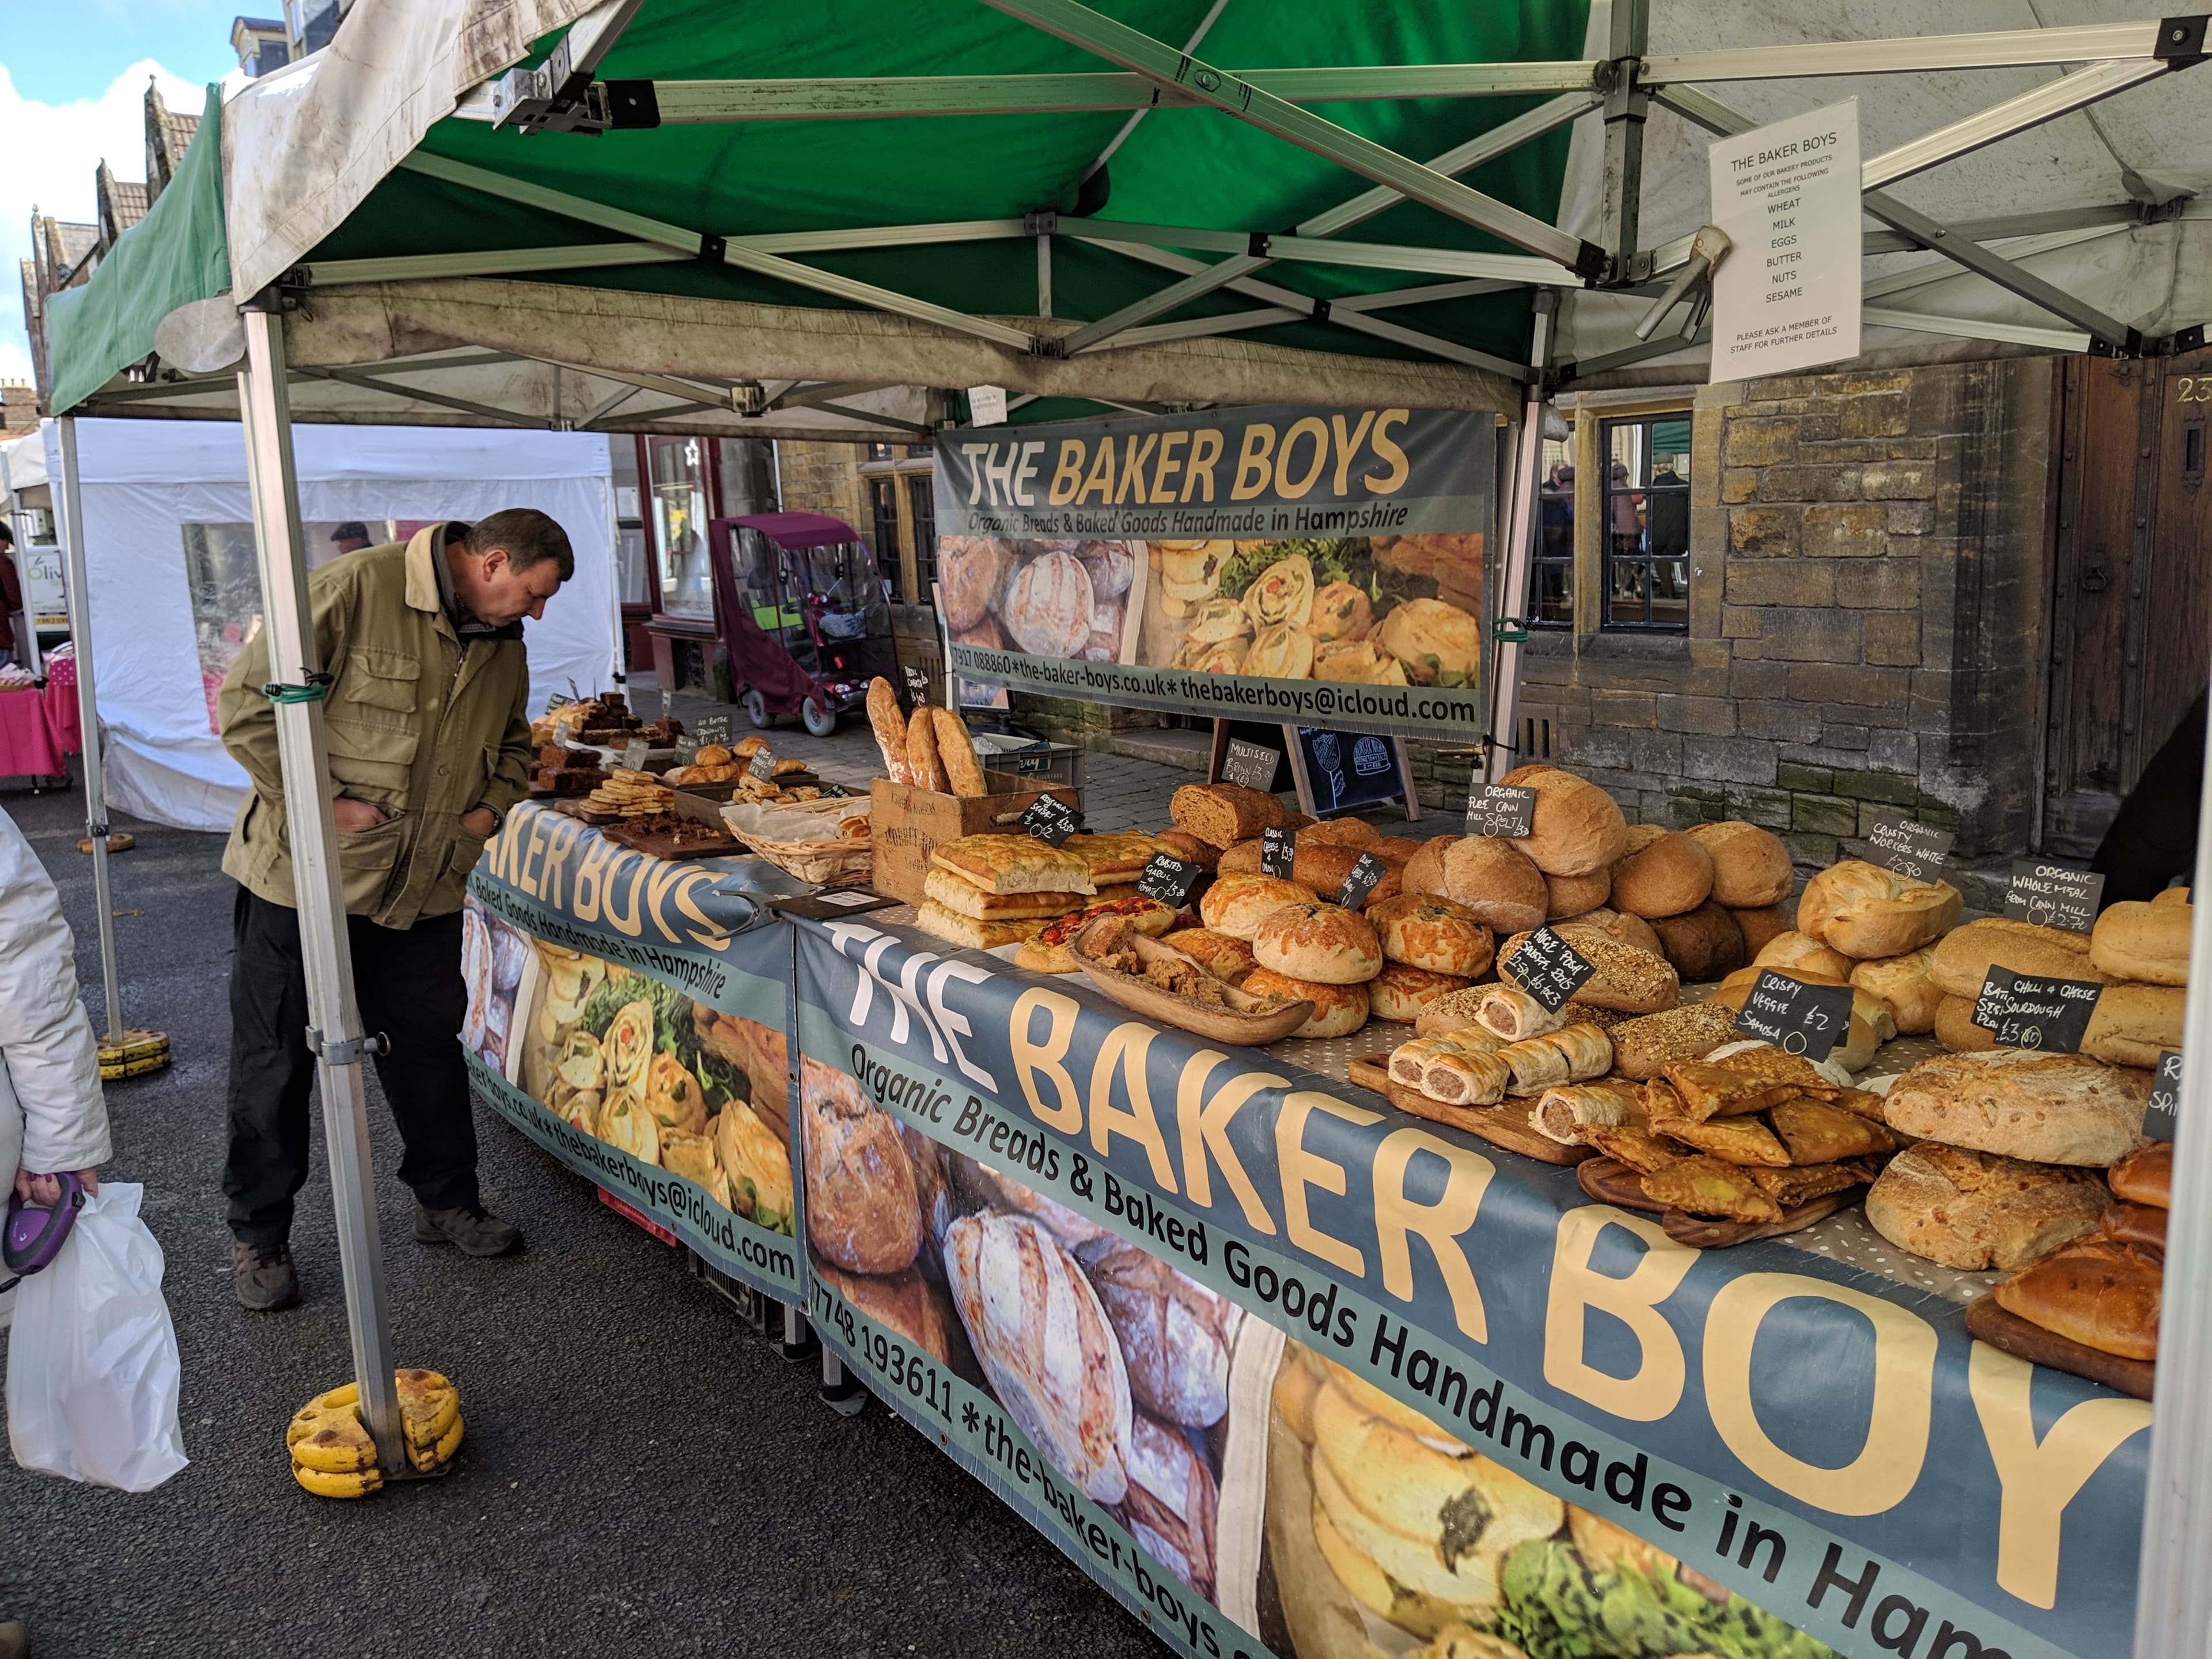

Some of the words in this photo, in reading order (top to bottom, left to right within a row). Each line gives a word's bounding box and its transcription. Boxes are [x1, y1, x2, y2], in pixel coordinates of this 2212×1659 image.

[1730, 155, 1754, 172] THE
[1759, 143, 1798, 165] BAKER
[1803, 132, 1837, 151] BOYS
[1763, 171, 1775, 179] OUR
[1777, 164, 1799, 175] BAKERY
[1801, 154, 1833, 168] PRODUCTS
[1740, 188, 1752, 196] MAY
[1753, 182, 1779, 193] CONTAIN
[1781, 178, 1792, 186] THE
[1793, 168, 1829, 183] FOLLOWING
[1767, 185, 1801, 198] ALLERGENS
[1767, 198, 1801, 214] WHEAT
[1772, 217, 1796, 230] MILK
[1771, 234, 1797, 249] EGGS
[1767, 252, 1802, 267] BUTTER
[1772, 271, 1797, 285] NUTS
[1766, 287, 1803, 304] SESAME
[1737, 330, 1763, 341] PLEASE
[1765, 327, 1779, 336] ASK
[1789, 319, 1819, 331] MEMBER
[1821, 316, 1832, 324] OF
[1730, 343, 1752, 354] STAFF
[1755, 340, 1768, 349] FOR
[1771, 334, 1803, 346] FURTHER
[1806, 327, 1837, 339] DETAILS
[2177, 377, 2212, 402] 23
[961, 441, 1046, 506] THE
[1048, 428, 1224, 505] BAKER
[1230, 408, 1410, 501] BOYS
[968, 512, 1019, 535] Organic
[1022, 513, 1059, 533] Breads
[1063, 517, 1073, 532] &
[1076, 511, 1116, 533] Baked
[1121, 509, 1167, 533] Goods
[1173, 507, 1265, 533] Handmade
[1271, 508, 1289, 531] in
[1296, 503, 1409, 535] Hampshire
[28, 565, 62, 581] Oliv
[974, 652, 1012, 675] 088860
[1019, 660, 1166, 696] the-baker-boys.co.uk
[1181, 677, 1475, 723] thebakerboys@icloud.com
[1230, 743, 1274, 765] MULTISEED
[1226, 758, 1251, 775] BROWN
[1485, 786, 1530, 798] ORGANIC
[1040, 794, 1072, 815] ROSEMARY
[1468, 797, 1489, 809] PURE
[1495, 801, 1518, 812] CANN
[1467, 811, 1484, 821] MILL
[1485, 813, 1518, 829] SPELT
[1900, 820, 1940, 839] ORGANIC
[1265, 827, 1283, 838] CLASSIC
[1873, 823, 1912, 844] CRUSTY
[1869, 834, 1913, 854] WORKERS
[1915, 847, 1945, 865] WHITE
[1146, 865, 1172, 881] GARLIC
[1156, 855, 1182, 872] ROASTED
[475, 809, 589, 910] AKER
[573, 835, 732, 952] BOYS
[2035, 865, 2097, 885] ORGANIC
[2013, 875, 2089, 900] WHOLEMEAL
[2029, 895, 2056, 910] CANN
[2059, 902, 2091, 917] MILL
[2046, 910, 2088, 930] £2.70
[476, 876, 503, 912] Baked
[505, 893, 538, 931] Goods
[538, 911, 623, 958] Handmade
[625, 941, 646, 967] in
[647, 947, 726, 1000] Hampshire
[1533, 927, 1559, 953] HUGE
[1762, 974, 1802, 999] CRISPY
[2060, 984, 2096, 1001] CHEESE
[1548, 990, 1562, 1006] 3
[1752, 991, 1790, 1014] VEGGIE
[2003, 997, 2066, 1019] SOURDOUGH
[1738, 1010, 1782, 1040] SAMOSA
[1804, 1005, 1830, 1031] £2
[553, 1122, 796, 1281] thebakerboys@icloud.com
[823, 922, 998, 1094] THE
[1010, 987, 1497, 1346] BAKER
[1543, 1204, 2153, 1611] BOY
[851, 1043, 952, 1124] Organic
[952, 1093, 1058, 1182] Breads
[1070, 1153, 1094, 1202] &
[1104, 1172, 1209, 1267] Baked
[1224, 1240, 1357, 1349] Goods
[1370, 1313, 1692, 1532] Handmade
[1716, 1494, 1787, 1584] in
[861, 1325, 952, 1425] 193611
[983, 1416, 1251, 1659] the-baker-boys.
